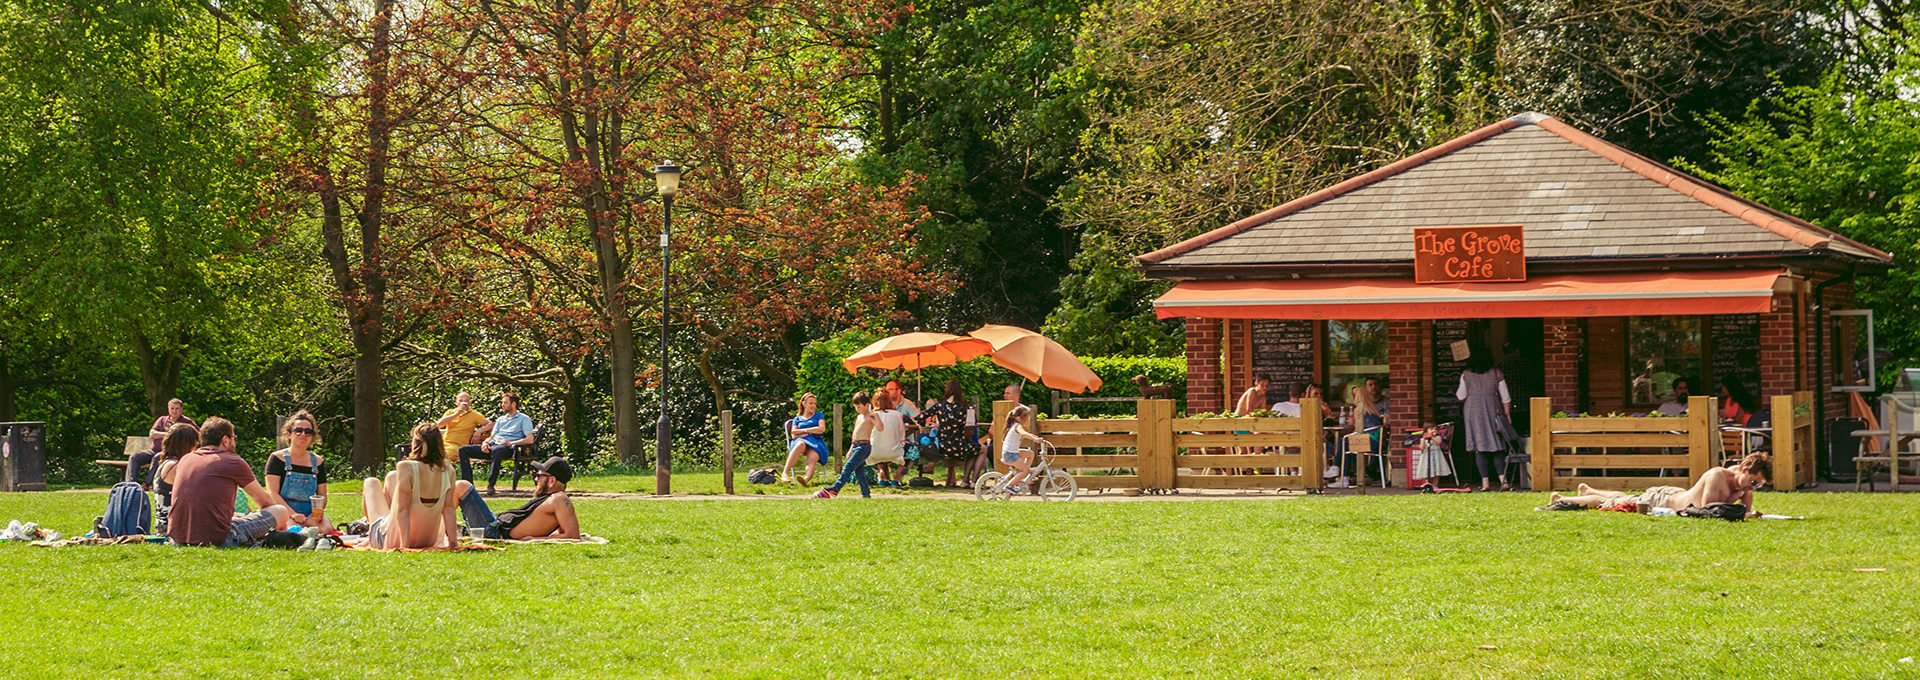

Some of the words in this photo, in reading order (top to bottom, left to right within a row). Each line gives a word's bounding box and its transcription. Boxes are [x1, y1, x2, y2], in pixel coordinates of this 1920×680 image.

[1416, 230, 1456, 256] The
[1461, 231, 1521, 256] Grove
[1444, 256, 1494, 278] Café
[1433, 304, 1468, 316] Grove
